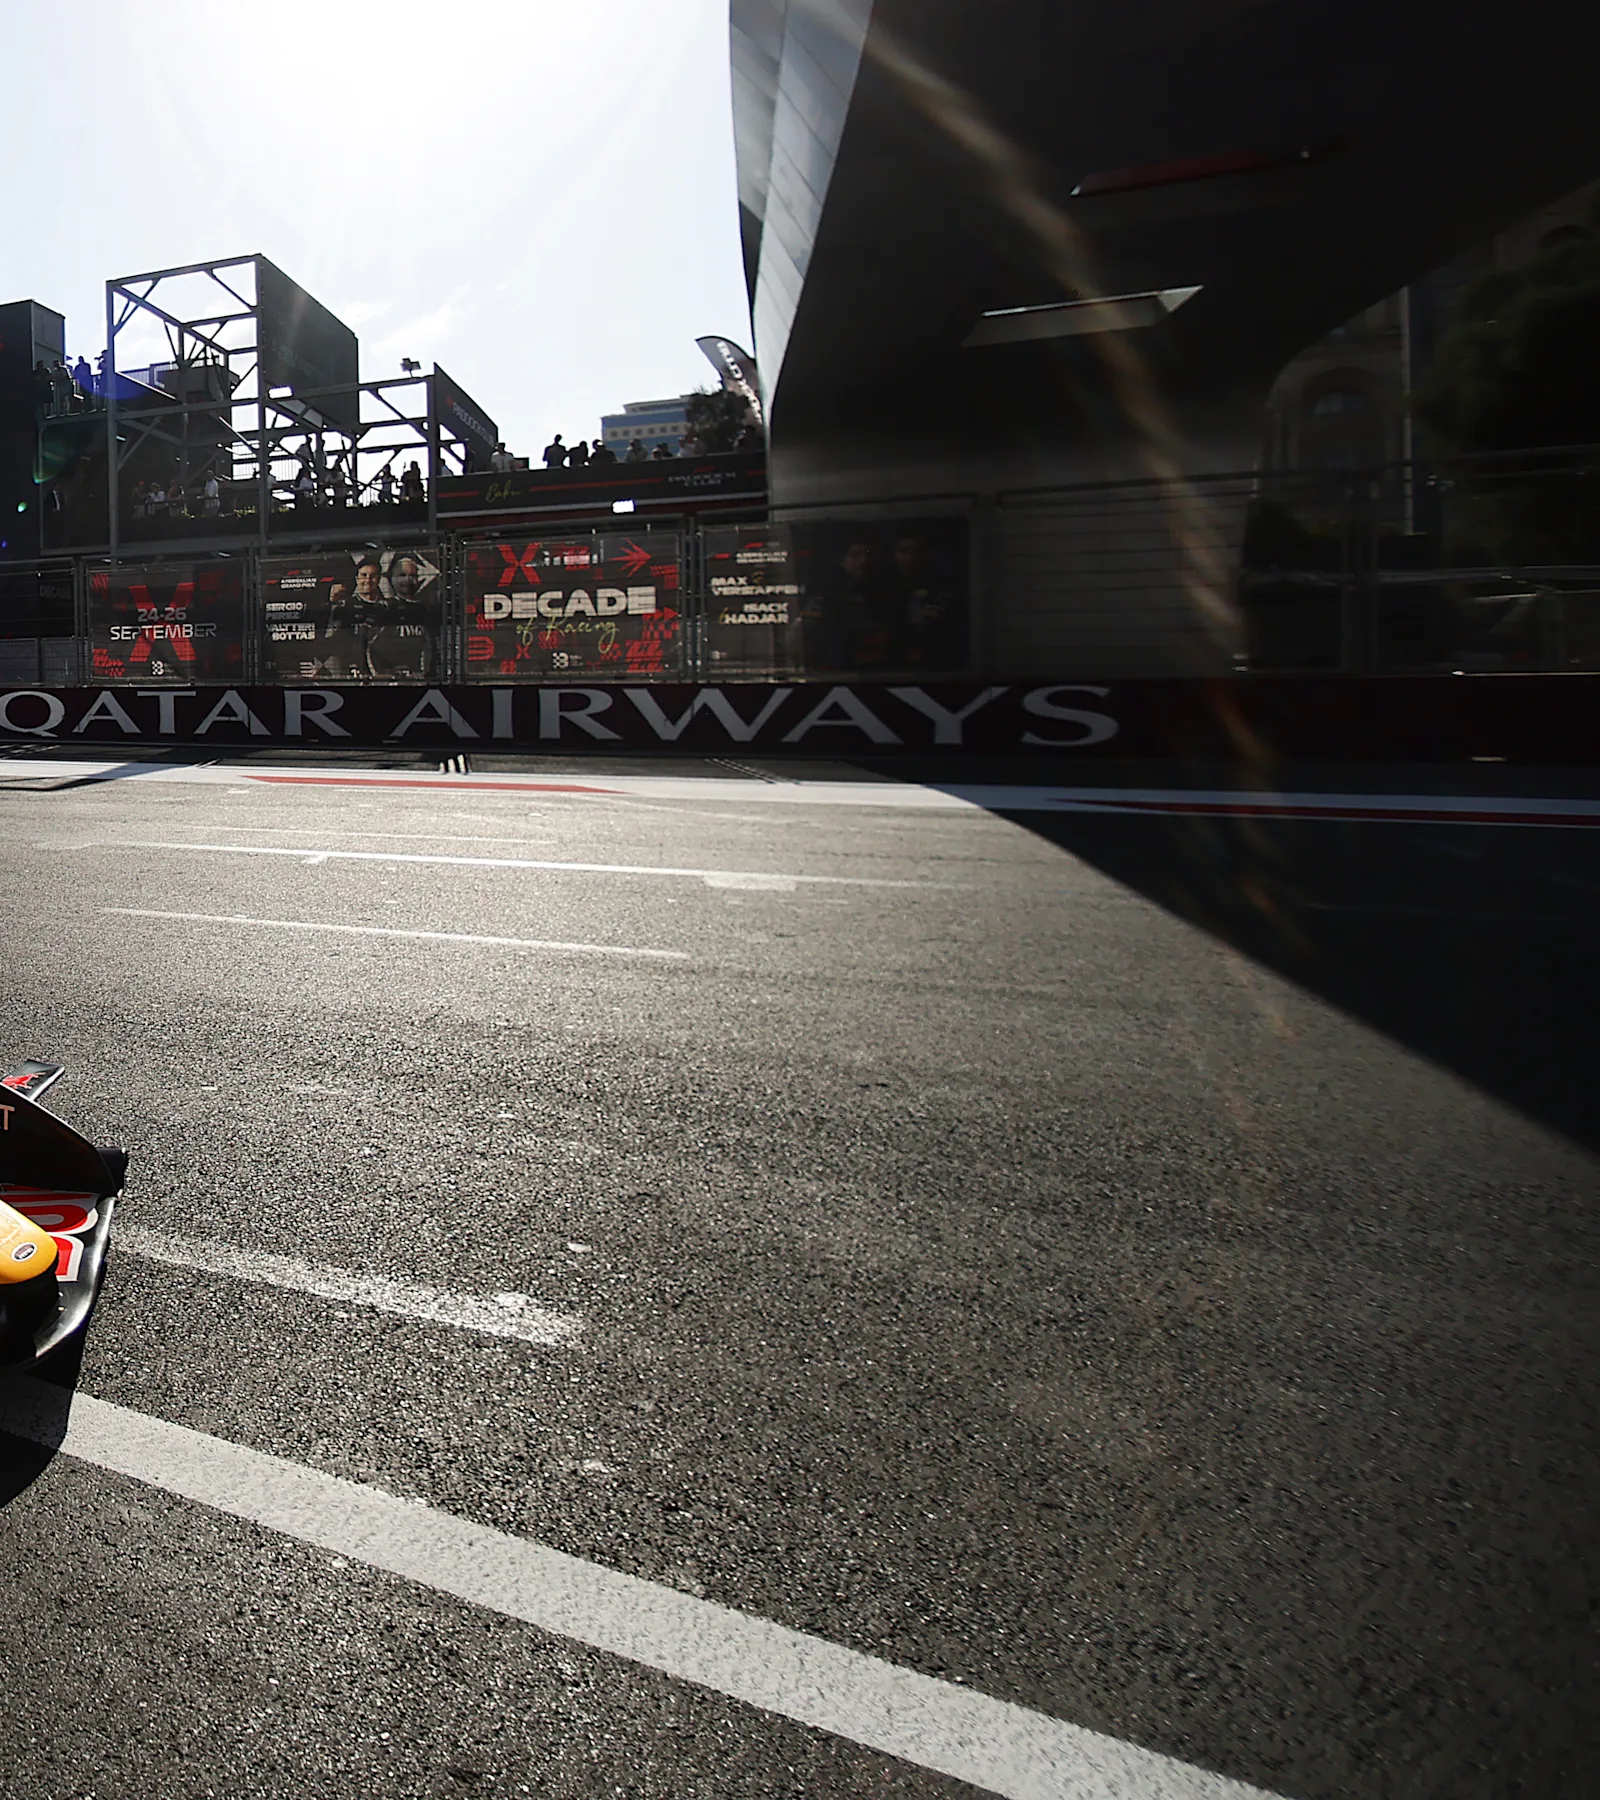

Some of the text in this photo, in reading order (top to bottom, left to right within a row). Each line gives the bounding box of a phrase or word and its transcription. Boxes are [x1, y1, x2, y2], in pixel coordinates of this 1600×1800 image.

[266, 602, 304, 612] SERGIO
[483, 586, 656, 620] DECADE
[138, 607, 188, 622] 24-26
[110, 623, 216, 641] SEPTEMBER
[387, 684, 1120, 747] AIRWAYS
